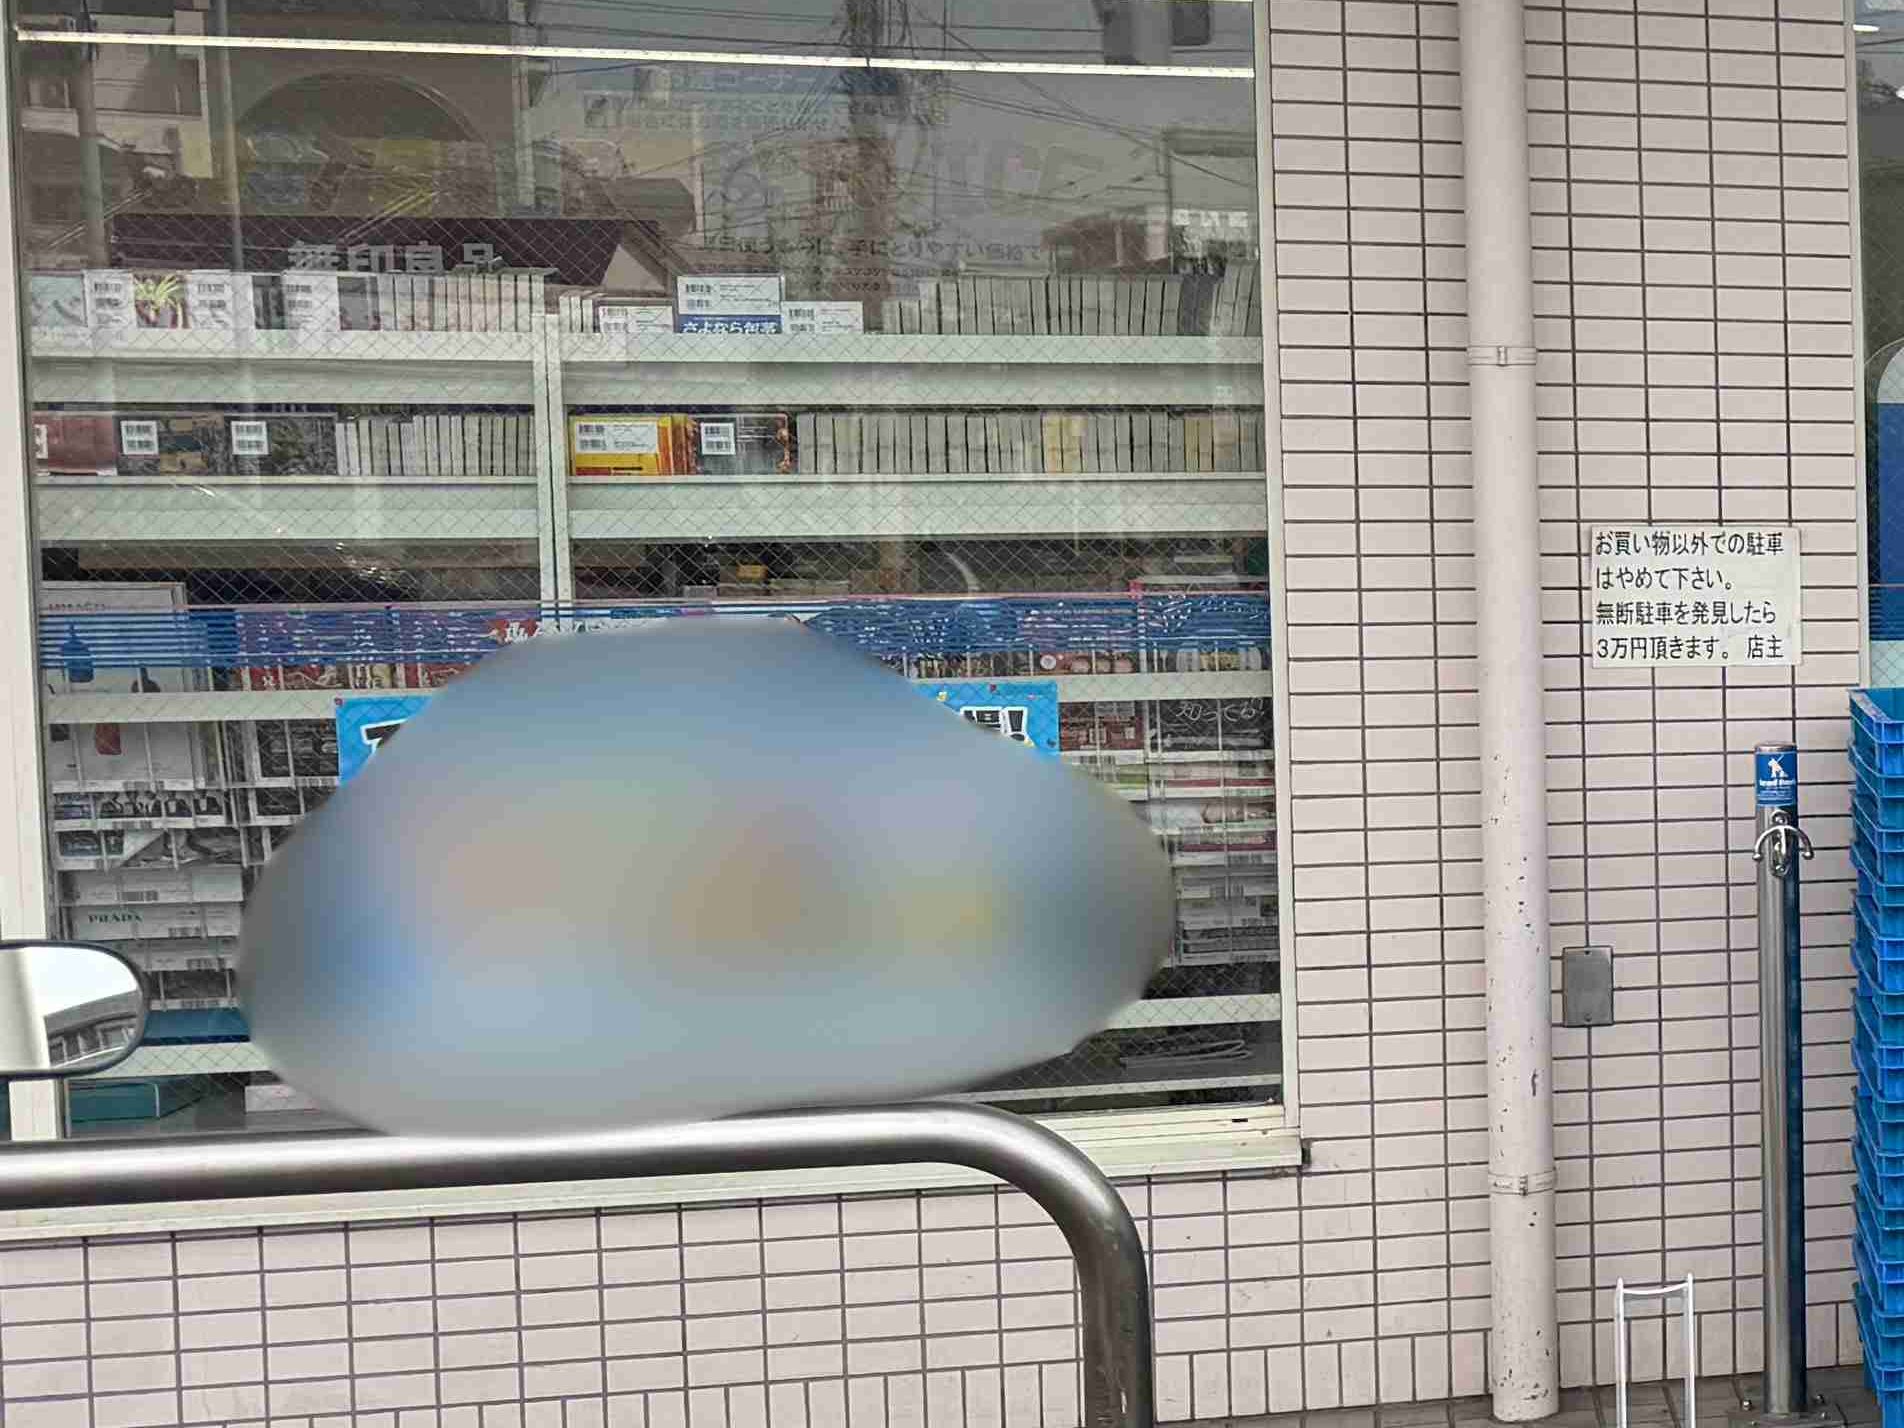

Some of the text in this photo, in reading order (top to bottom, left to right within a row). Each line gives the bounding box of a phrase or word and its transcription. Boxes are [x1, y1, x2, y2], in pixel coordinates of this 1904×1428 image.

[1595, 531, 1784, 557] お買い物以外での駐車
[1595, 567, 1733, 590] はやめて下さい。
[1595, 601, 1777, 625] 無断駐車を発見したら
[1747, 634, 1784, 660] 店主
